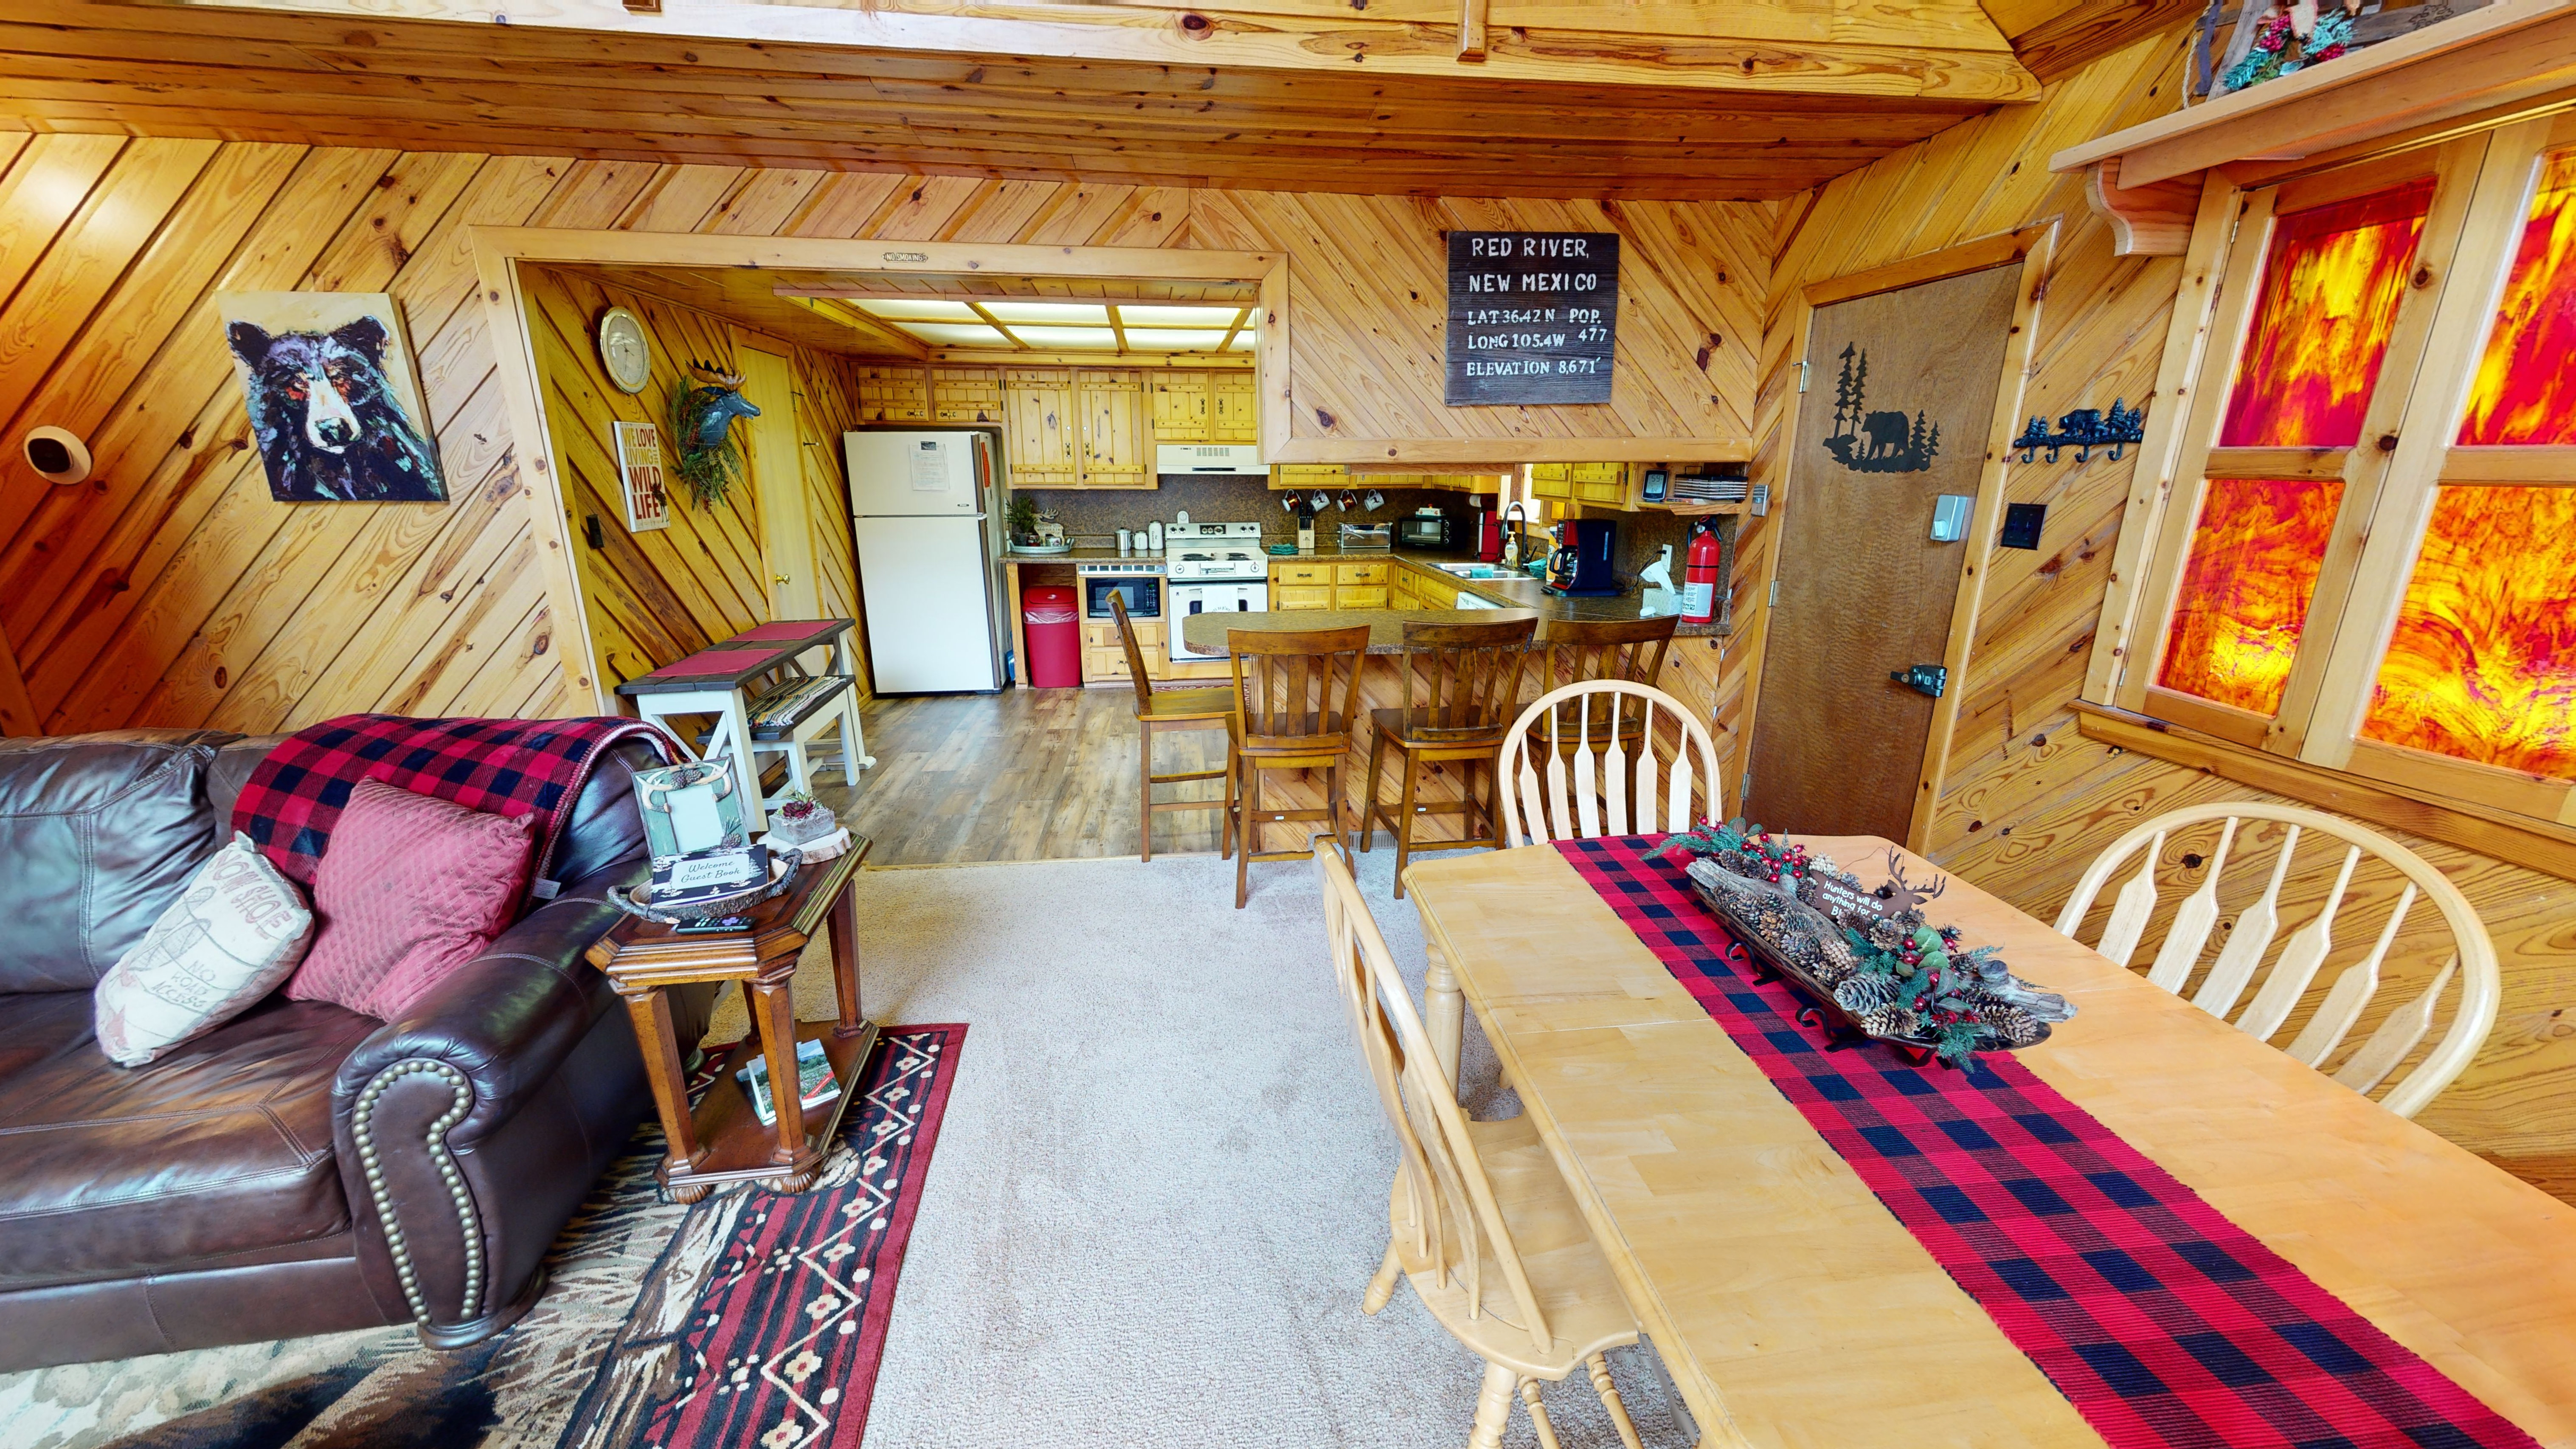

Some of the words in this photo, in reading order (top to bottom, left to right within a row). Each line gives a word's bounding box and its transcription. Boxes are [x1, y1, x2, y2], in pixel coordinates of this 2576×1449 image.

[1472, 238, 1512, 256] RED
[1523, 238, 1589, 258] RIVER,
[1469, 274, 1510, 292] NEW
[1522, 273, 1597, 291] MEXICO
[1468, 309, 1500, 325] LAT
[1569, 308, 1601, 324] POP.
[1468, 334, 1508, 349] LONG
[1512, 333, 1565, 348] 105.4W
[1578, 329, 1607, 341] 477
[1467, 361, 1550, 376] ELEVATION
[622, 428, 636, 447] WE
[636, 428, 656, 447] LOVE
[625, 448, 653, 465] LIVING
[628, 466, 661, 492] WILD
[633, 493, 660, 520] LIFE
[681, 872, 713, 883] Guest
[715, 868, 740, 878] Book
[689, 861, 735, 872] Welcome
[1822, 893, 1856, 911] anything
[1857, 905, 1871, 916] for
[1824, 881, 1855, 900] Hunters
[1856, 895, 1870, 906] will
[1871, 900, 1883, 911] do
[187, 959, 216, 982] NO
[171, 971, 208, 995] ROAD
[151, 980, 207, 1007] ACCESS
